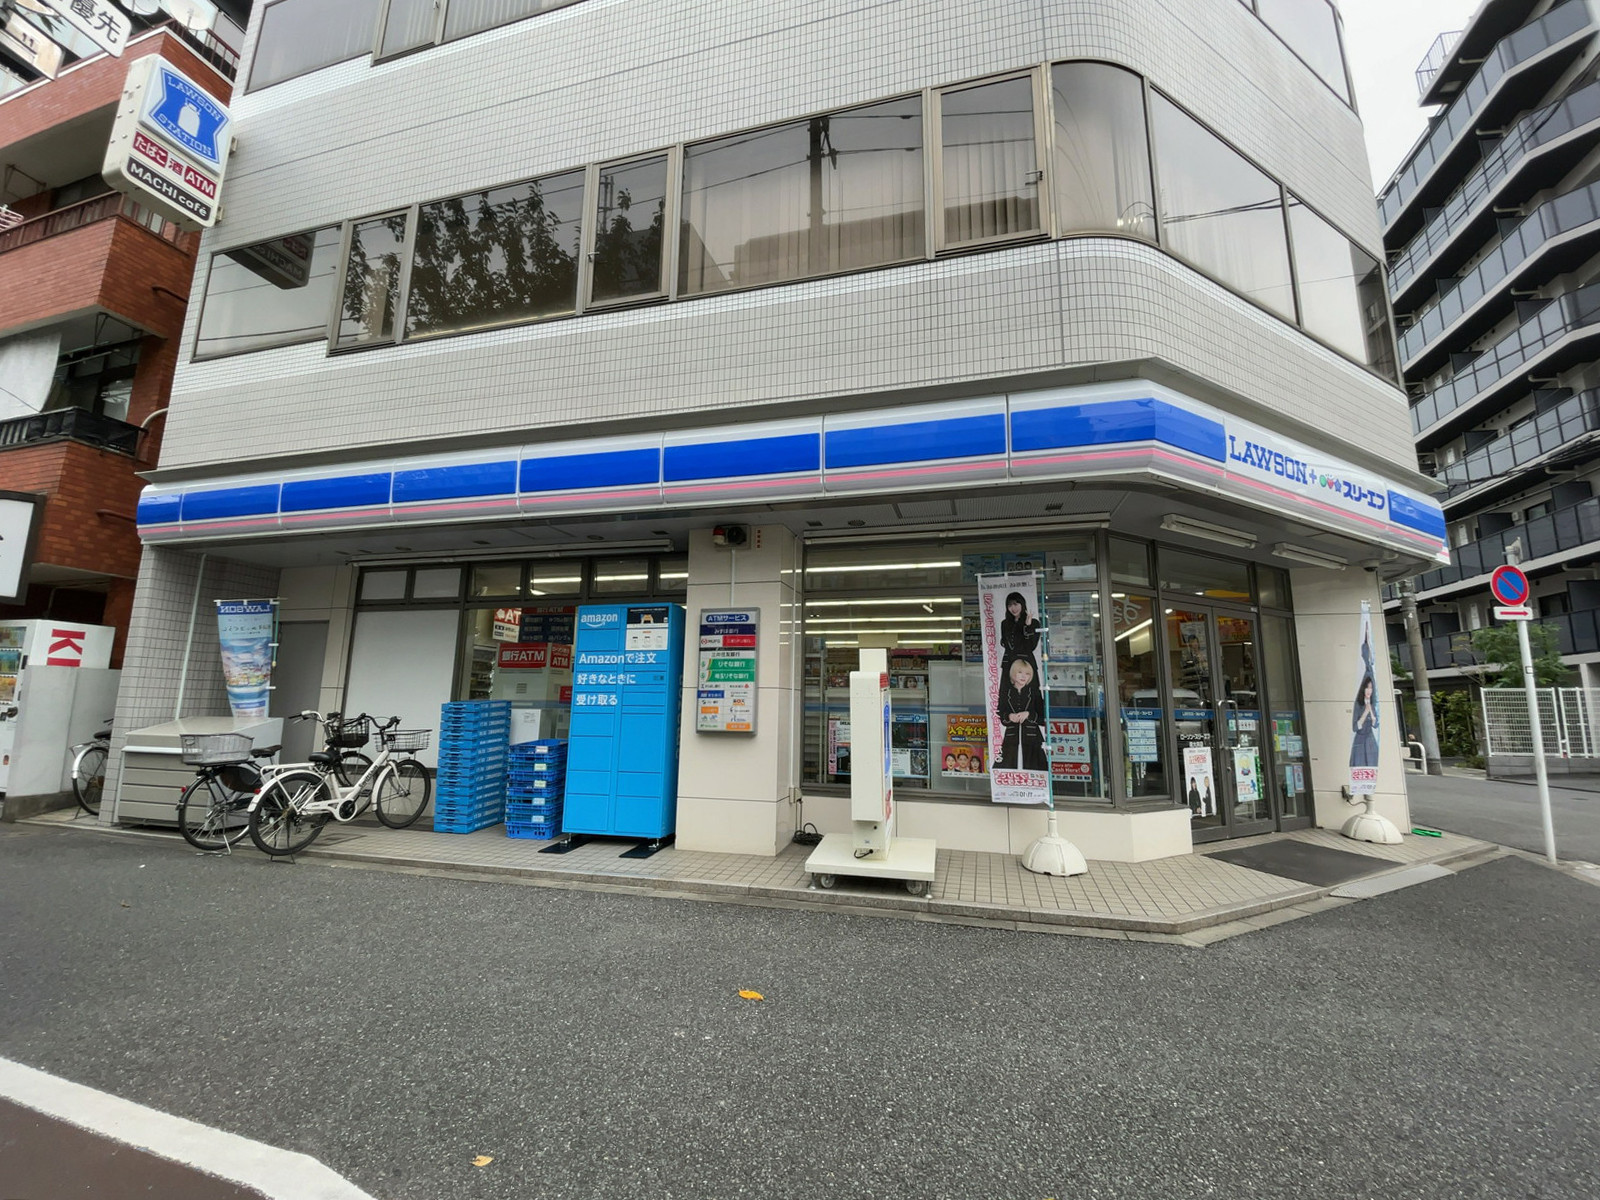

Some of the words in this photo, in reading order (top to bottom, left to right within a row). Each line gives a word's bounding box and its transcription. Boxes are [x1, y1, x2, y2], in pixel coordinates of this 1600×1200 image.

[167, 75, 221, 121] LAWSON
[157, 112, 213, 156] STATION
[135, 136, 167, 165] たばこ
[186, 171, 214, 196] ATM
[131, 163, 177, 199] MACHI
[180, 195, 207, 217] café
[581, 613, 618, 623] amazon
[501, 650, 545, 661] 銀行ATM
[579, 652, 656, 664] Amazonで注文
[552, 656, 568, 667] ATM
[577, 673, 636, 684] 好きなときに
[576, 694, 618, 705] 受け取る
[1050, 723, 1080, 734] ATM
